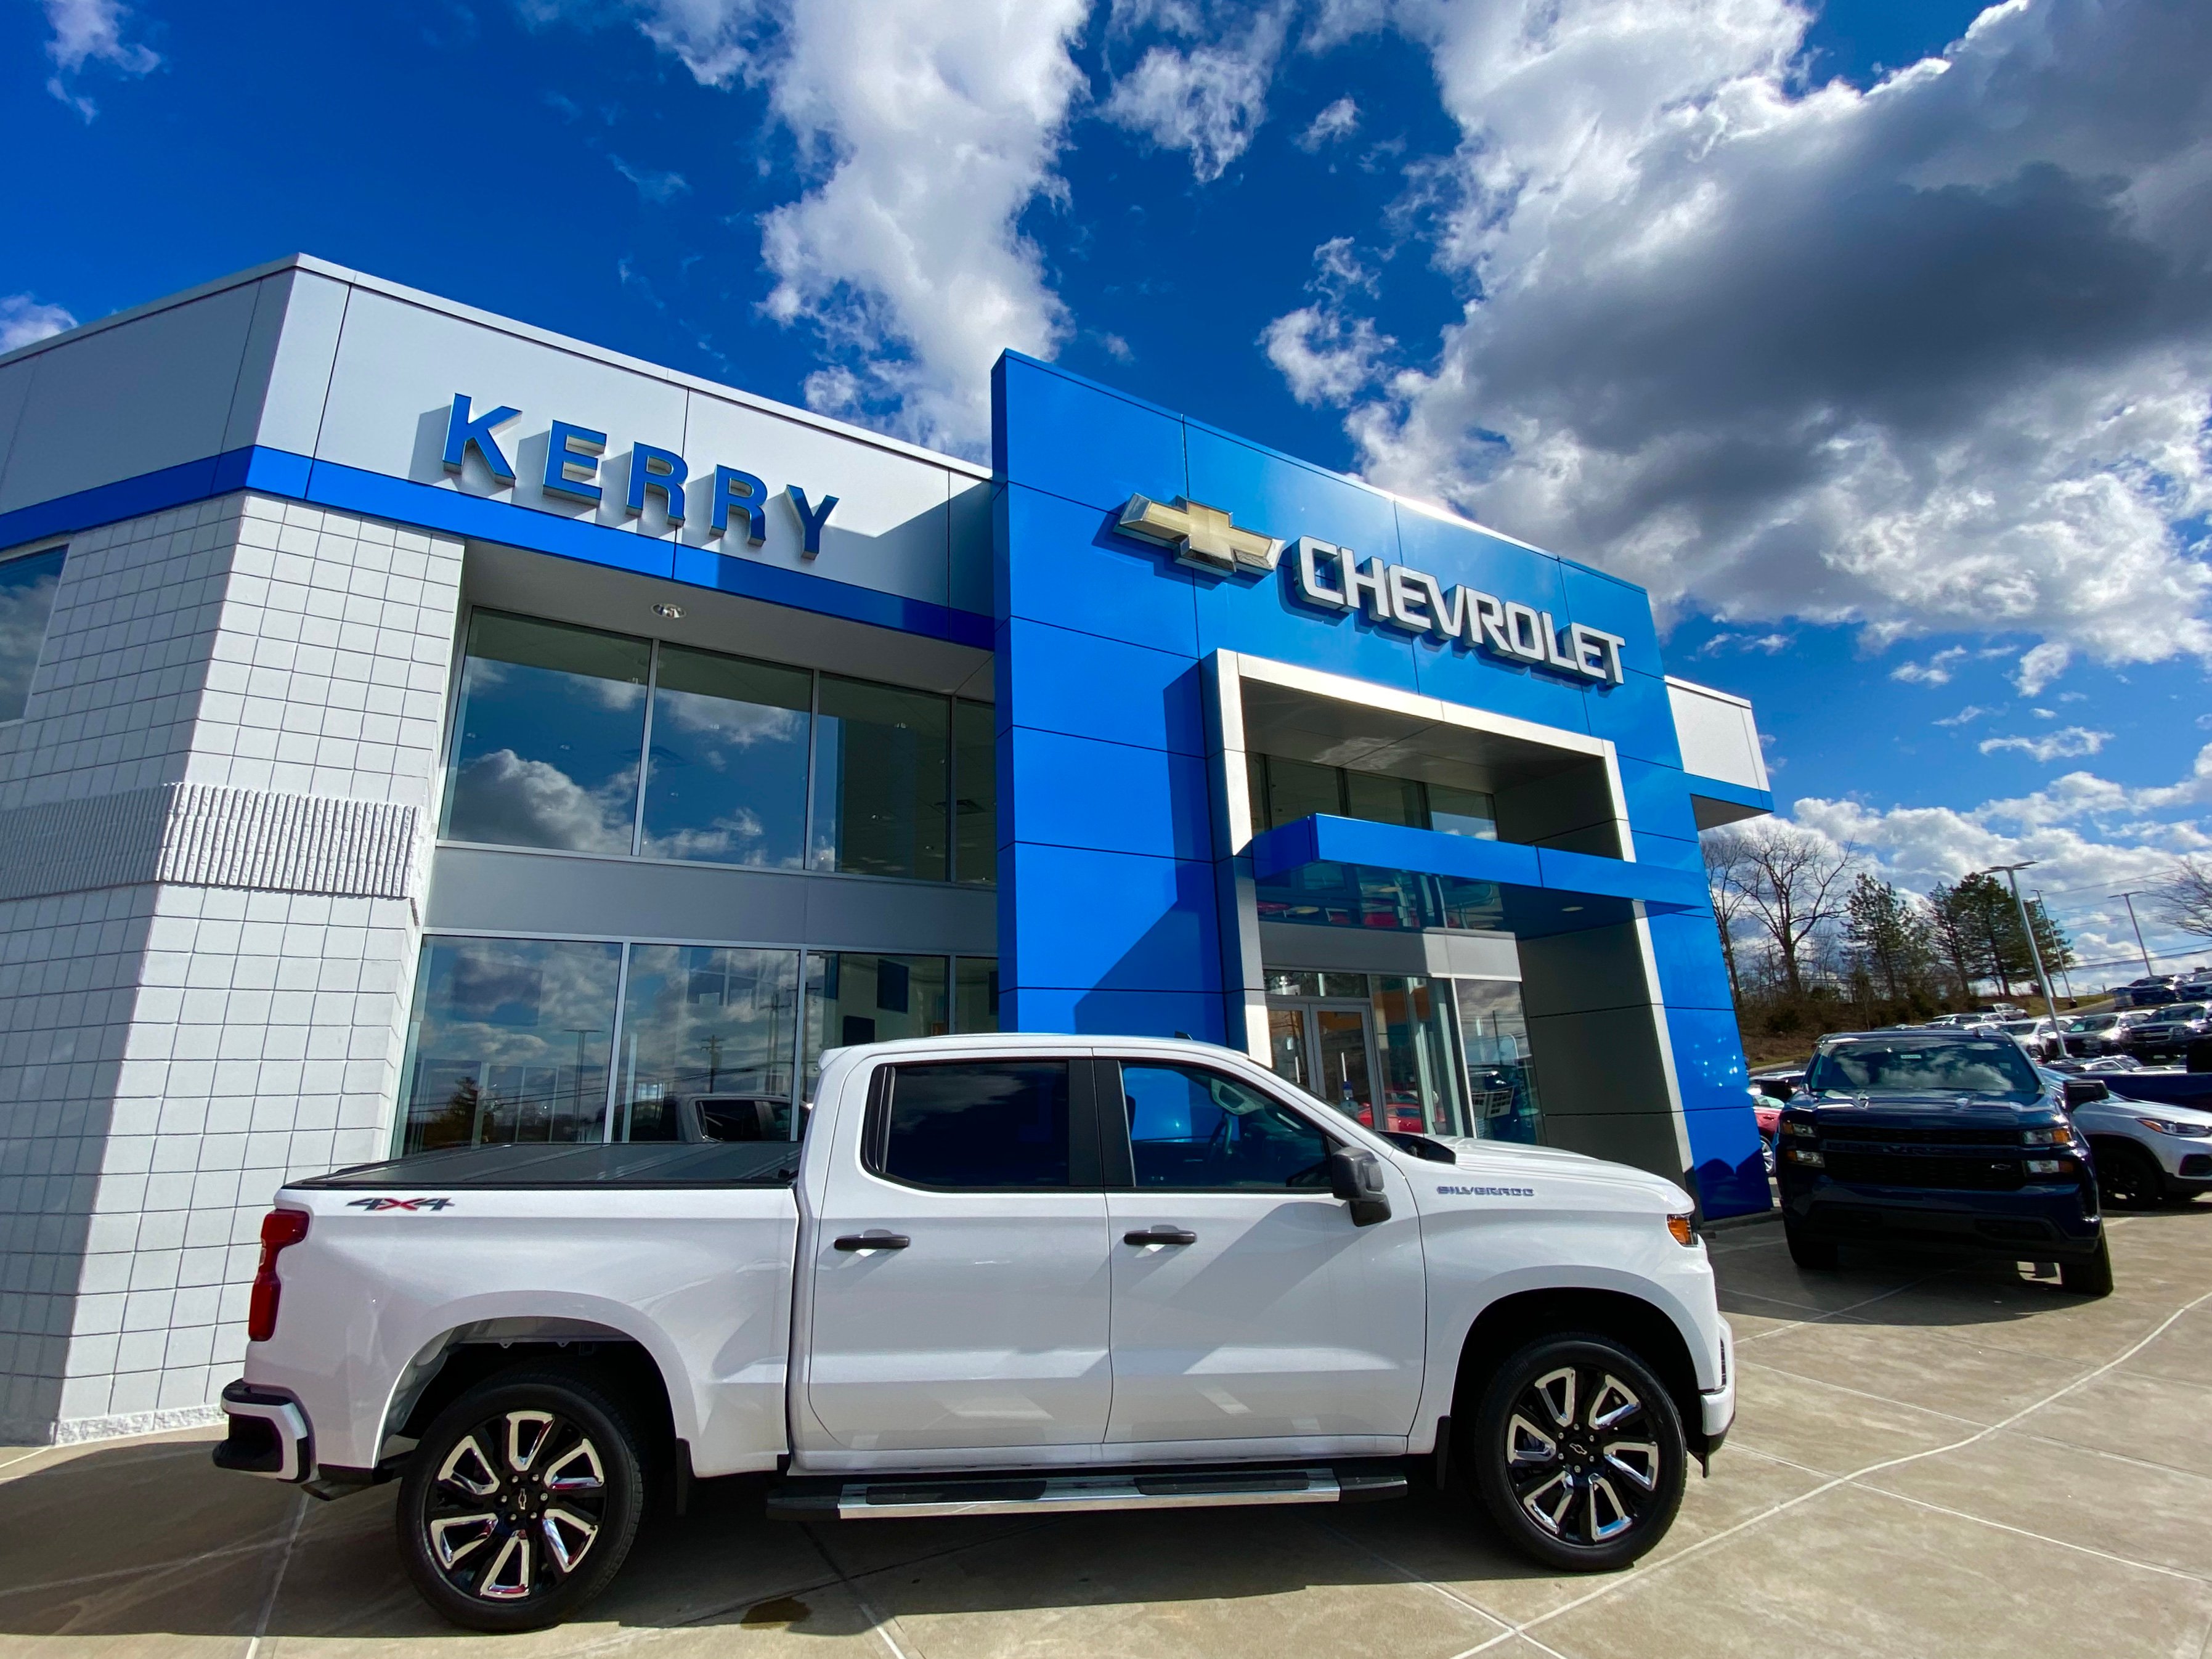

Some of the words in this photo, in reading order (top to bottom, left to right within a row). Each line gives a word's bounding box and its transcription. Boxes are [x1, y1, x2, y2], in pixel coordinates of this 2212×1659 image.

[442, 393, 839, 558] KERRY
[1293, 535, 1625, 687] CHEVROLET
[1436, 1186, 1534, 1197] SILVERADO
